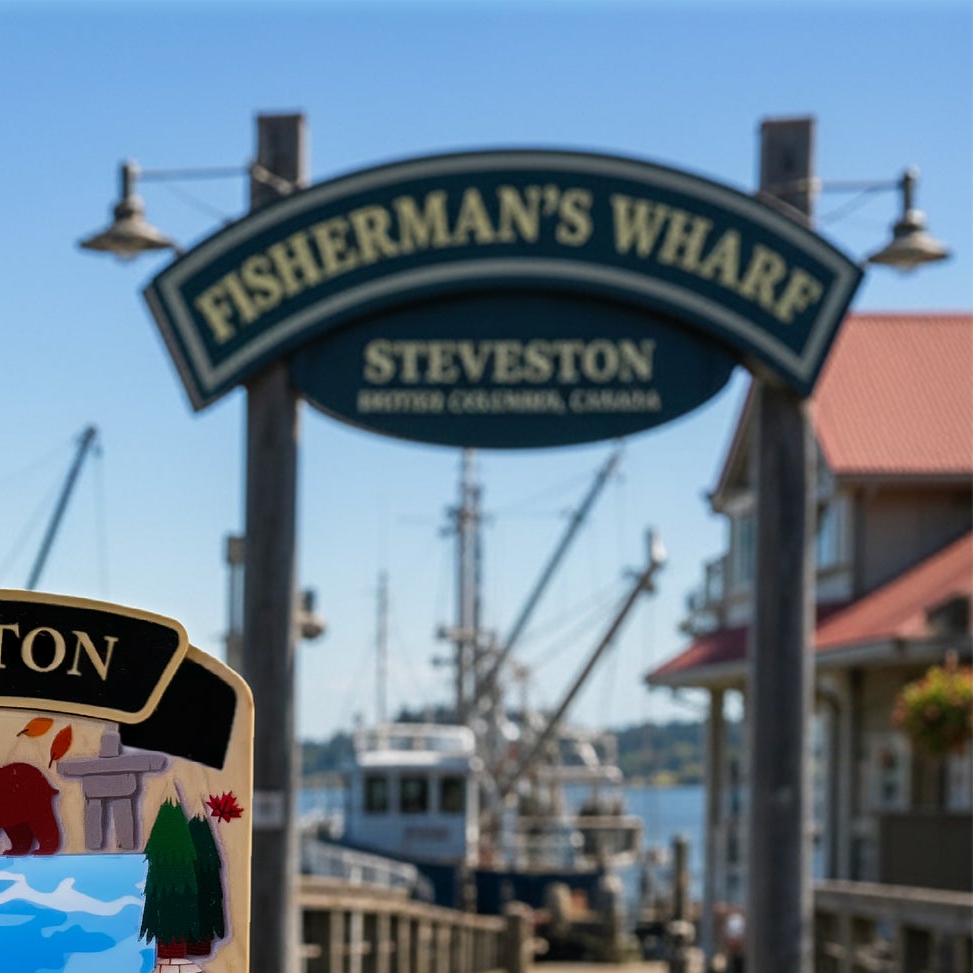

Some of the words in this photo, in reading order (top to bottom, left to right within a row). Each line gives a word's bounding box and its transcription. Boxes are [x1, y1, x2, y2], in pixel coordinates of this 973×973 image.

[194, 184, 594, 345] FISHERMAN'S
[610, 194, 823, 325] WHARF
[363, 338, 656, 384] STEVESTON
